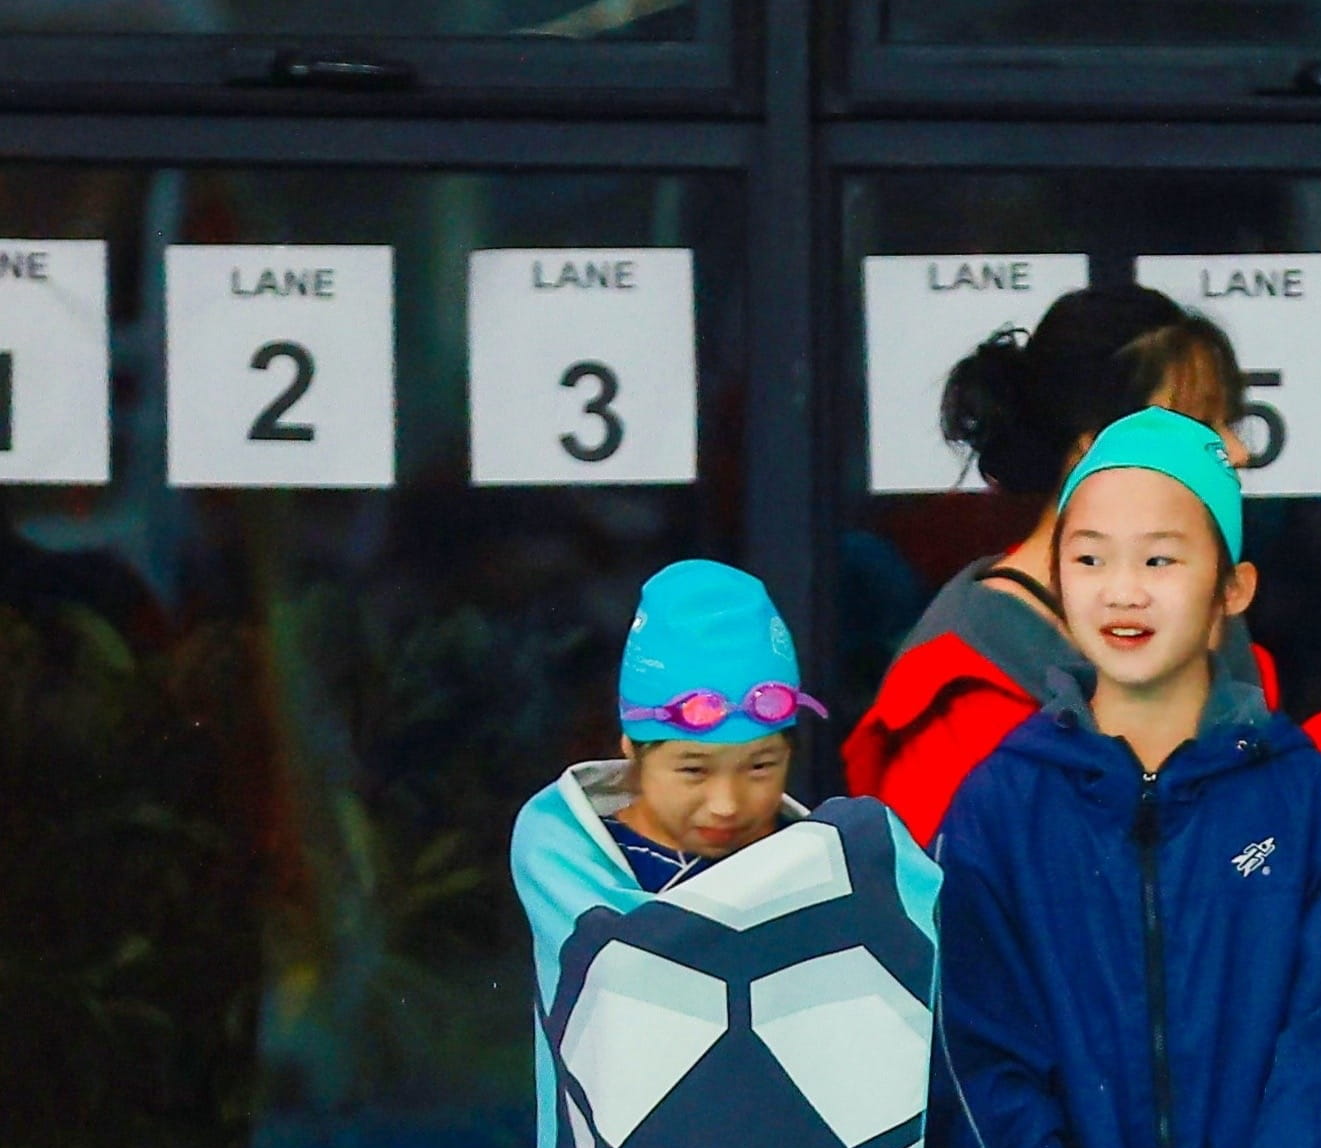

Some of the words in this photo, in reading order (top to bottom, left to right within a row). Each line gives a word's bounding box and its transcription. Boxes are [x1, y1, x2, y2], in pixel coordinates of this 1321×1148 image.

[0, 251, 49, 281] NE
[532, 260, 636, 291] LANE
[928, 262, 1031, 291] LANE
[231, 268, 335, 299] LANE
[1202, 268, 1304, 300] LANE
[246, 340, 317, 443] 2
[558, 360, 626, 463] 3
